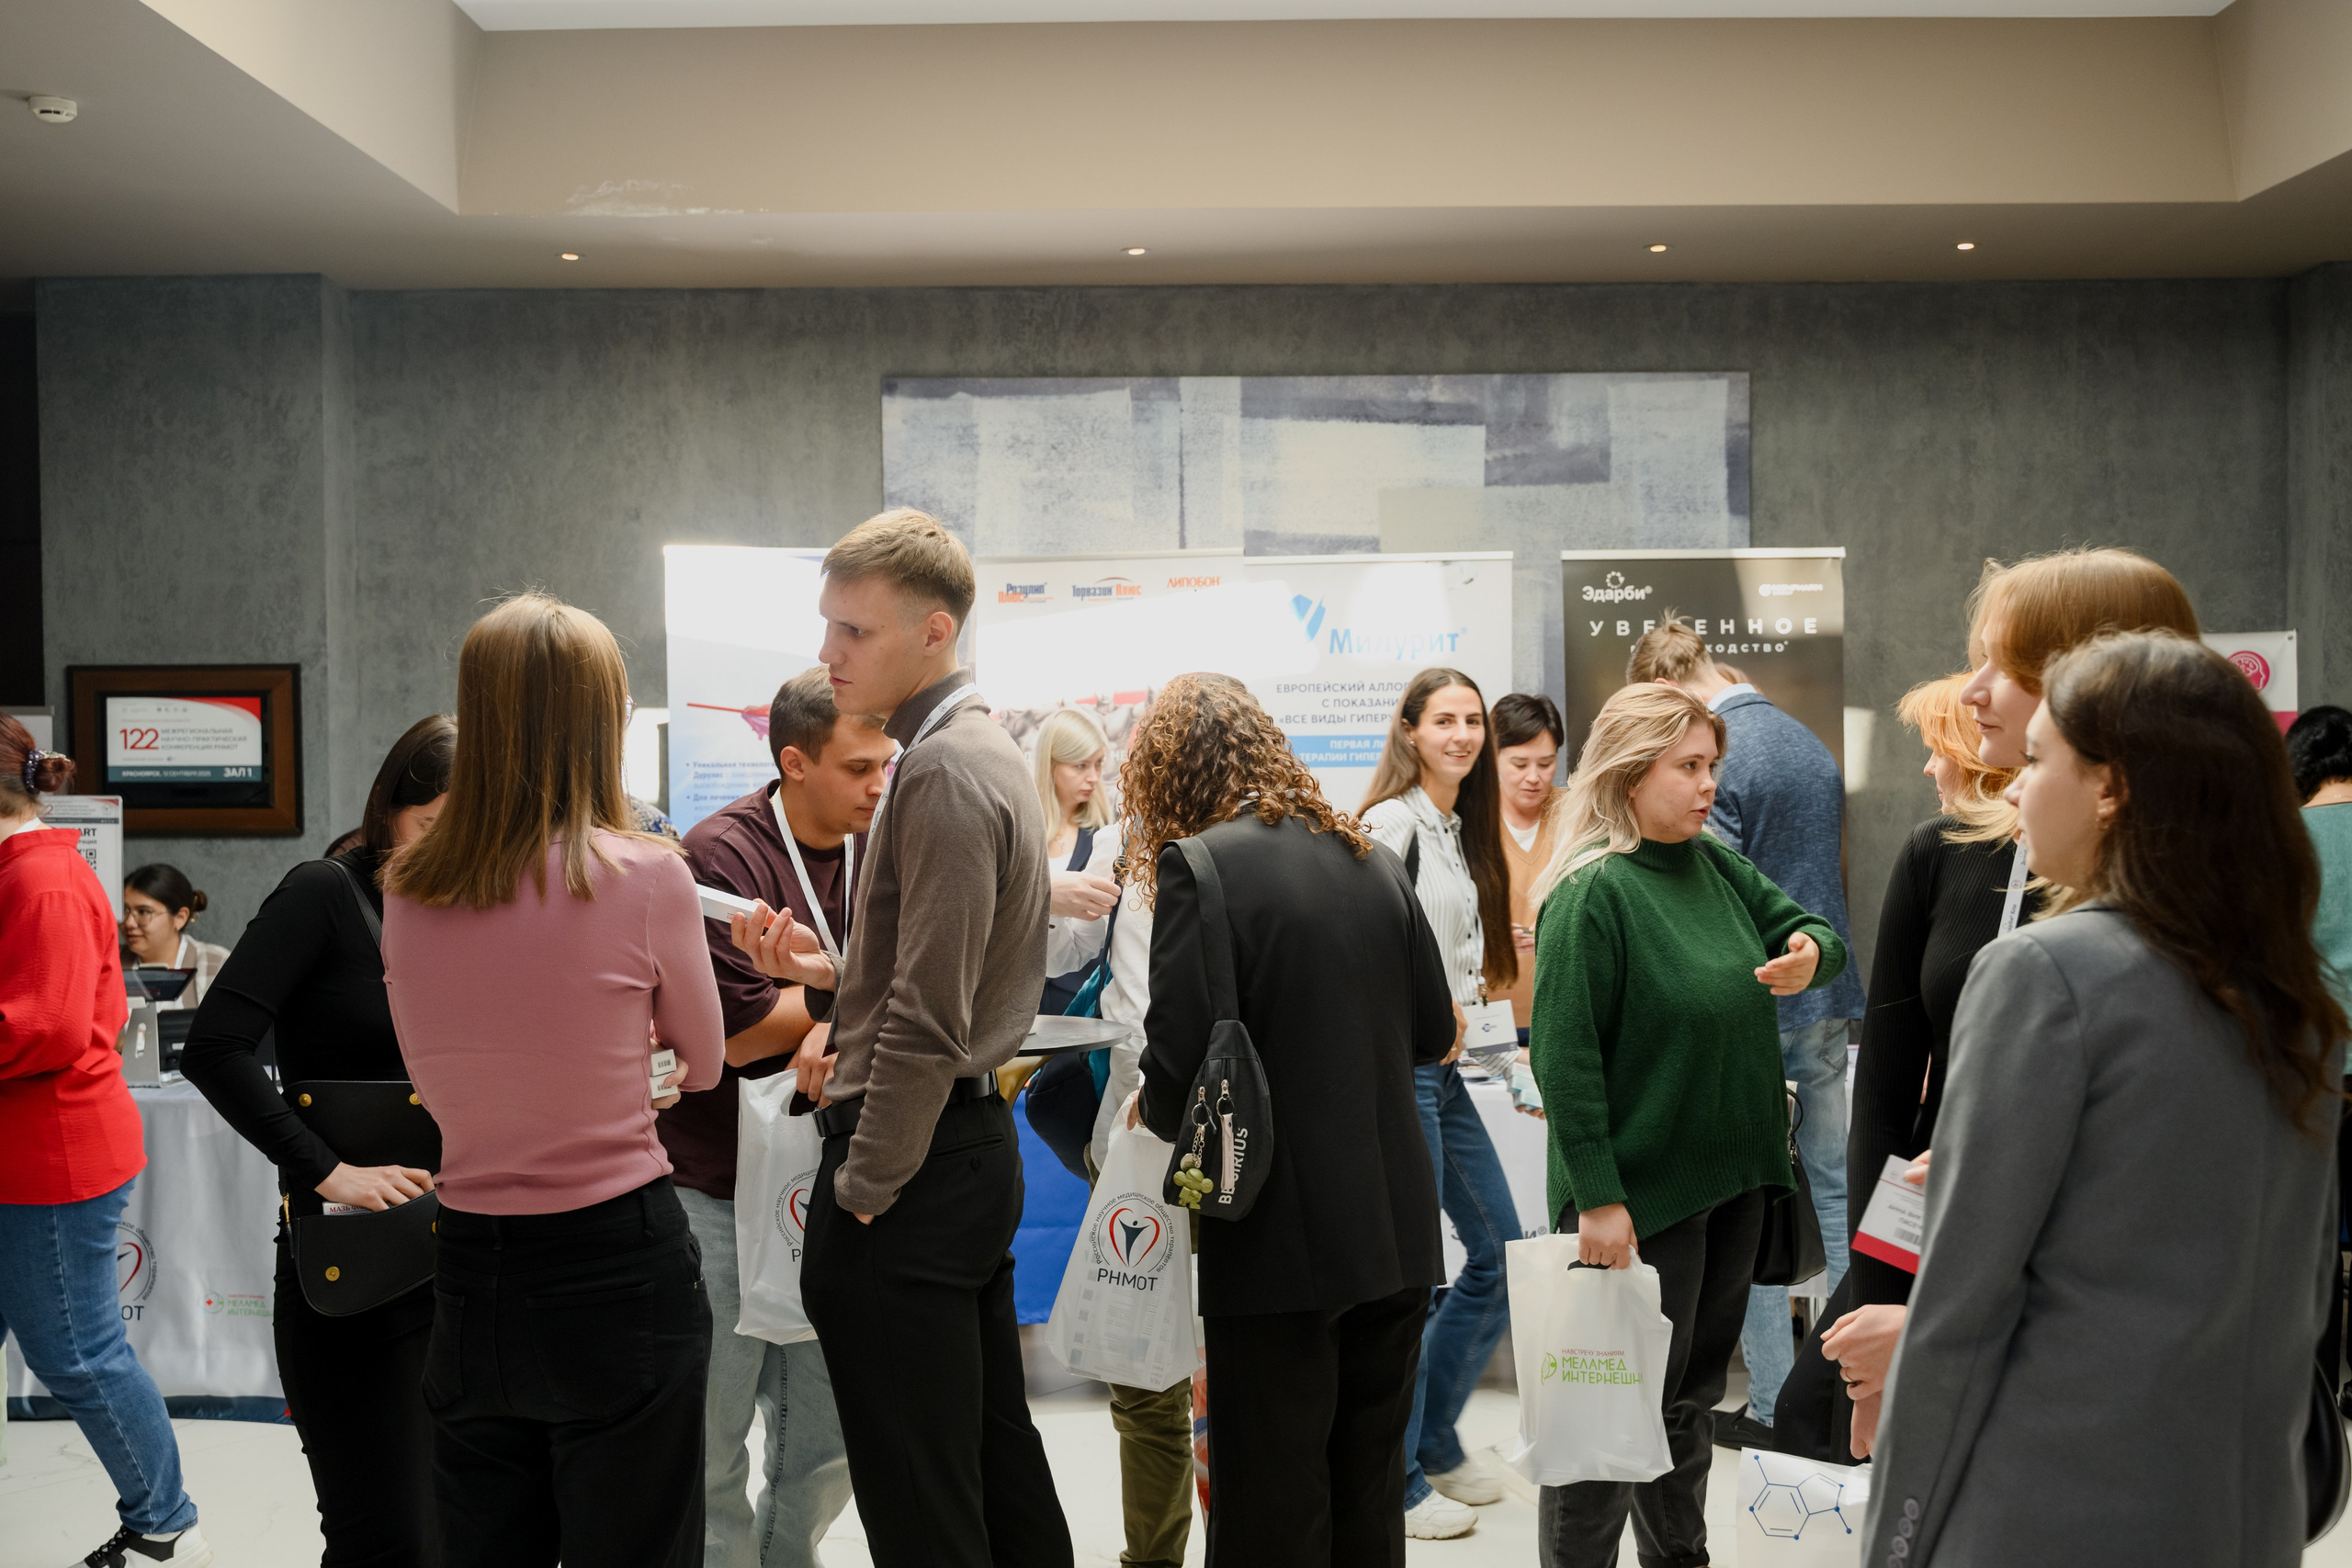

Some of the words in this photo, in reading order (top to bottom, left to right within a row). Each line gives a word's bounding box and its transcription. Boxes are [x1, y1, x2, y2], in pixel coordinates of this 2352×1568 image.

[1589, 616, 1818, 637] УВЕЕННОЕ
[1276, 681, 1365, 693] ЕВРОПЕЙСКИЙ
[1322, 699, 1329, 708] С
[1333, 698, 1399, 707] ПОКАЗАНИ
[1280, 715, 1307, 724] «ВСЕ
[1311, 715, 1347, 724] ВИДЫ
[119, 728, 159, 750] 122
[1330, 739, 1371, 750] ПЕРВАЯ
[1300, 753, 1347, 762] ТЕРАПИИ
[223, 767, 246, 778] ЗАЛ
[1095, 1197, 1117, 1223] научное
[1154, 1202, 1174, 1235] общество
[1090, 1223, 1102, 1265] Российское
[1156, 1235, 1175, 1273] терапевтов
[1097, 1268, 1159, 1291] РНМОТ
[1562, 1357, 1627, 1371] МЕЛАМЕД
[1562, 1371, 1644, 1385] ИНТЕРНЕШН
